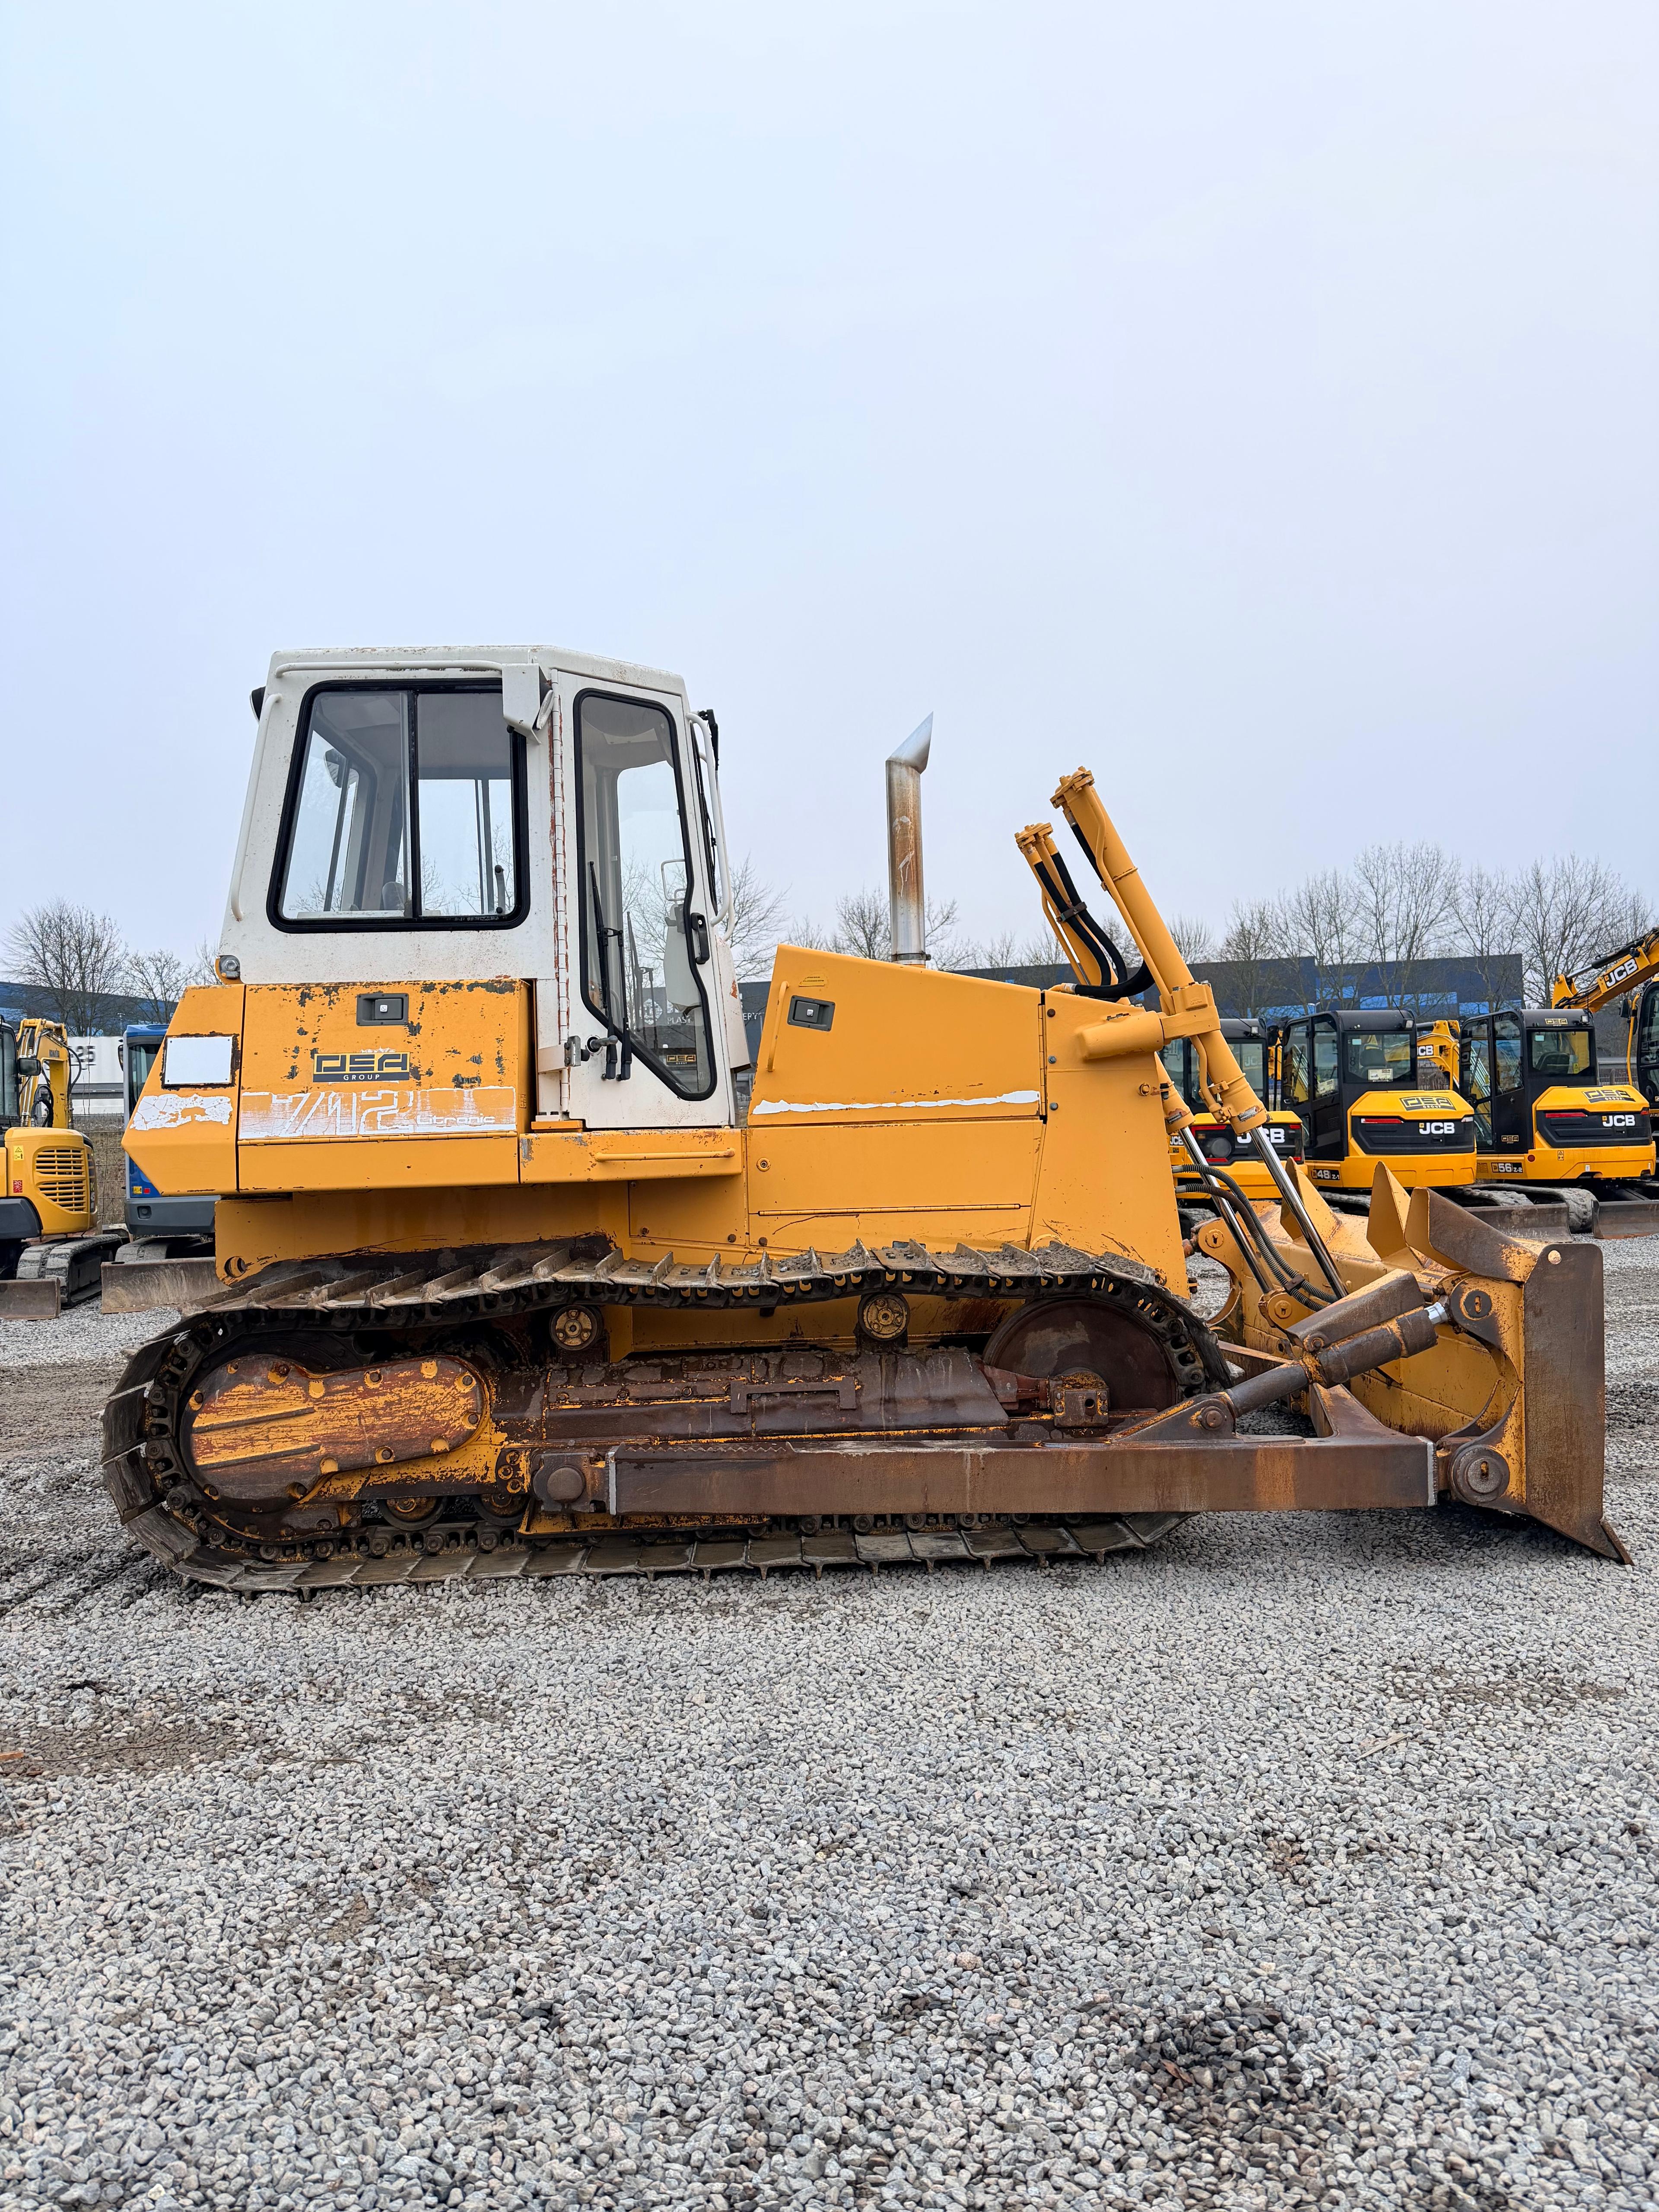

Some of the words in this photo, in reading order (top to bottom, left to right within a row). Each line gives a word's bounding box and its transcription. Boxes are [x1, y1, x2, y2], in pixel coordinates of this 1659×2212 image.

[1606, 959, 1637, 987] JCB
[73, 1046, 96, 1062] 25
[1417, 1045, 1433, 1055] CB
[316, 1053, 408, 1073] DEA
[1602, 1115, 1635, 1127] JCB
[1419, 1122, 1455, 1135] JCB
[1498, 1163, 1512, 1172] 56
[1317, 1170, 1330, 1179] 48
